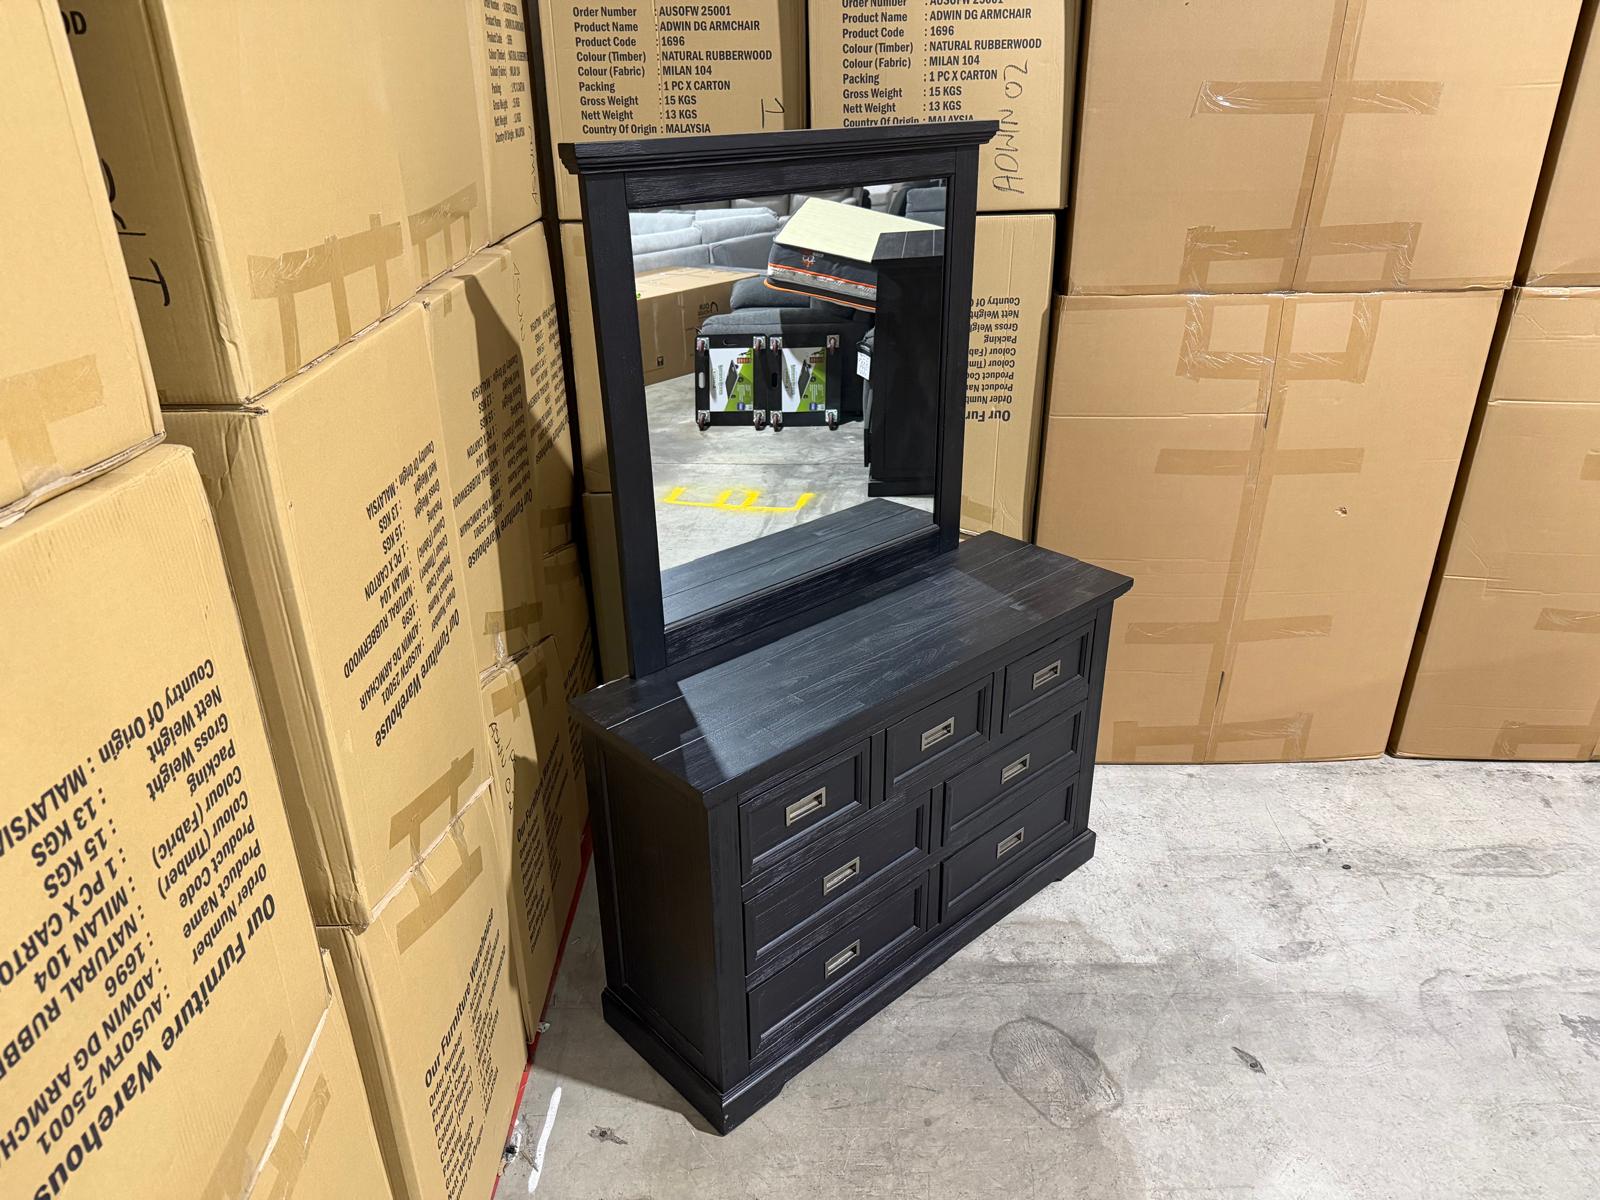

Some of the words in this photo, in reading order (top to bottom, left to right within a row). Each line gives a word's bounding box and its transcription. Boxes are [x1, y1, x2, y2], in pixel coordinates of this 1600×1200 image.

[572, 6, 599, 17] Order
[600, 6, 637, 17] Number
[659, 6, 699, 16] AUSOFW
[701, 5, 731, 16] 25001
[574, 22, 610, 32] Product
[612, 22, 638, 32] Name
[660, 21, 691, 32] ADWIN
[694, 21, 707, 31] DG
[709, 20, 760, 31] ARMCHAIR
[842, 12, 879, 24] Product
[881, 12, 908, 22] Name
[930, 10, 962, 21] ADWIN
[964, 9, 978, 20] DG
[980, 8, 1032, 20] ARMCHAIR
[575, 36, 612, 47] Product
[613, 36, 636, 47] Code
[662, 36, 685, 46] 1696
[842, 28, 879, 39] Product
[880, 27, 904, 38] Code
[930, 25, 954, 36] 1696
[842, 43, 873, 54] Colour
[874, 42, 913, 55] (Timber)
[929, 40, 972, 52] NATURAL
[974, 38, 1042, 50] RUBBERWOOD
[576, 52, 606, 62] Colour
[608, 51, 646, 64] (Timber)
[662, 50, 704, 61] NATURAL
[706, 50, 772, 61] RUBBERWOOD
[578, 66, 608, 76] Colour
[609, 66, 645, 78] (Fabric)
[662, 65, 692, 76] MILAN
[695, 65, 712, 75] 104
[842, 58, 873, 69] Colour
[874, 57, 911, 70] (Fabric)
[929, 56, 960, 66] MILAN
[962, 54, 980, 66] 104
[578, 81, 616, 94] Packing
[664, 81, 669, 91] 1
[671, 80, 684, 91] PC
[686, 80, 692, 90] X
[694, 80, 730, 90] CARTON
[842, 89, 869, 99] Gross
[870, 88, 902, 100] Weight
[929, 86, 941, 97] 15
[943, 86, 962, 96] KGS
[843, 73, 880, 86] Packing
[930, 71, 935, 82] 1
[937, 70, 950, 82] PC
[952, 70, 958, 81] X
[960, 69, 998, 81] CARTON
[580, 96, 606, 106] Gross
[607, 96, 639, 108] Weight
[664, 95, 676, 105] 15
[678, 95, 697, 105] KGS
[581, 110, 601, 120] Nett
[602, 110, 634, 122] Weight
[665, 109, 676, 120] 13
[679, 109, 698, 119] KGS
[843, 104, 863, 114] Nett
[864, 102, 896, 114] Weight
[929, 101, 940, 111] 13
[942, 100, 962, 111] KGS
[582, 124, 617, 136] Country
[618, 124, 629, 134] Of
[630, 124, 657, 136] Origin
[666, 123, 711, 134] MALAYSIA
[975, 296, 986, 307] Of
[986, 296, 1020, 307] Country
[1000, 308, 1019, 319] Nett
[969, 322, 993, 332] Weig
[982, 334, 1017, 344] Packing
[993, 322, 1018, 332] Gross
[968, 346, 987, 357] (Fab
[987, 358, 1015, 368] Colour
[988, 346, 1016, 356] Colour
[980, 382, 1013, 392] Product
[981, 370, 1014, 380] Product
[965, 394, 988, 404] Numb
[987, 409, 1011, 422] Our
[988, 394, 1012, 404] Order
[366, 482, 396, 520] MALAYSIA
[391, 503, 399, 521] 13
[378, 511, 392, 534] KGS
[394, 524, 402, 542] 15
[382, 532, 395, 555] KGS
[393, 548, 402, 568] PC
[401, 544, 406, 557] 1
[388, 557, 394, 574] X
[391, 564, 410, 594] MILAN
[364, 564, 389, 601] CARTON
[380, 585, 392, 609] 104
[388, 584, 413, 621] NATURAL
[402, 603, 416, 630] 1696
[449, 608, 460, 633] Our
[344, 614, 388, 678] RUBBERWOOD
[401, 621, 418, 654] ADWIN
[420, 625, 450, 679] Furniture
[392, 646, 401, 666] DG
[400, 640, 422, 680] AUSOFW
[165, 659, 214, 710] Country
[359, 658, 392, 711] ARMCHAIR
[381, 672, 400, 706] 25001
[147, 701, 164, 730] Of
[194, 685, 222, 722] Nett
[375, 673, 422, 747] Warehouse
[98, 716, 146, 763] Origin
[146, 710, 196, 764] Weight
[194, 713, 228, 752] Gross
[146, 746, 196, 802] Weight
[186, 738, 236, 797] Packing
[205, 766, 242, 813] Colour
[0, 765, 88, 857] MALAYSI
[73, 796, 97, 830] 13
[212, 790, 248, 838] Colour
[31, 819, 72, 867] KGS
[84, 828, 107, 862] 15
[152, 802, 204, 869] (Fabric)
[210, 814, 255, 874] Product
[44, 850, 84, 899] KGS
[104, 857, 118, 880] 1
[158, 828, 211, 900] (Timber)
[218, 838, 261, 899] Product
[79, 870, 105, 906] PC
[179, 866, 211, 908] Code
[237, 863, 266, 906] Order
[62, 895, 79, 922] X
[73, 886, 128, 954] MILAN
[183, 891, 219, 938] Name
[246, 894, 275, 940] Our
[192, 900, 237, 965] Number
[0, 913, 63, 986] CARTO
[60, 914, 138, 1002] NATURAL
[34, 944, 71, 993] 104
[105, 942, 145, 998] 1696
[102, 967, 154, 1040] ADWIN
[161, 932, 246, 1051] Furniture
[73, 1031, 102, 1071] DG
[99, 993, 162, 1085] AUSOFW
[0, 1063, 71, 1160] ARMCH
[34, 1050, 159, 1200] Warehous
[36, 1075, 97, 1154] 25001
